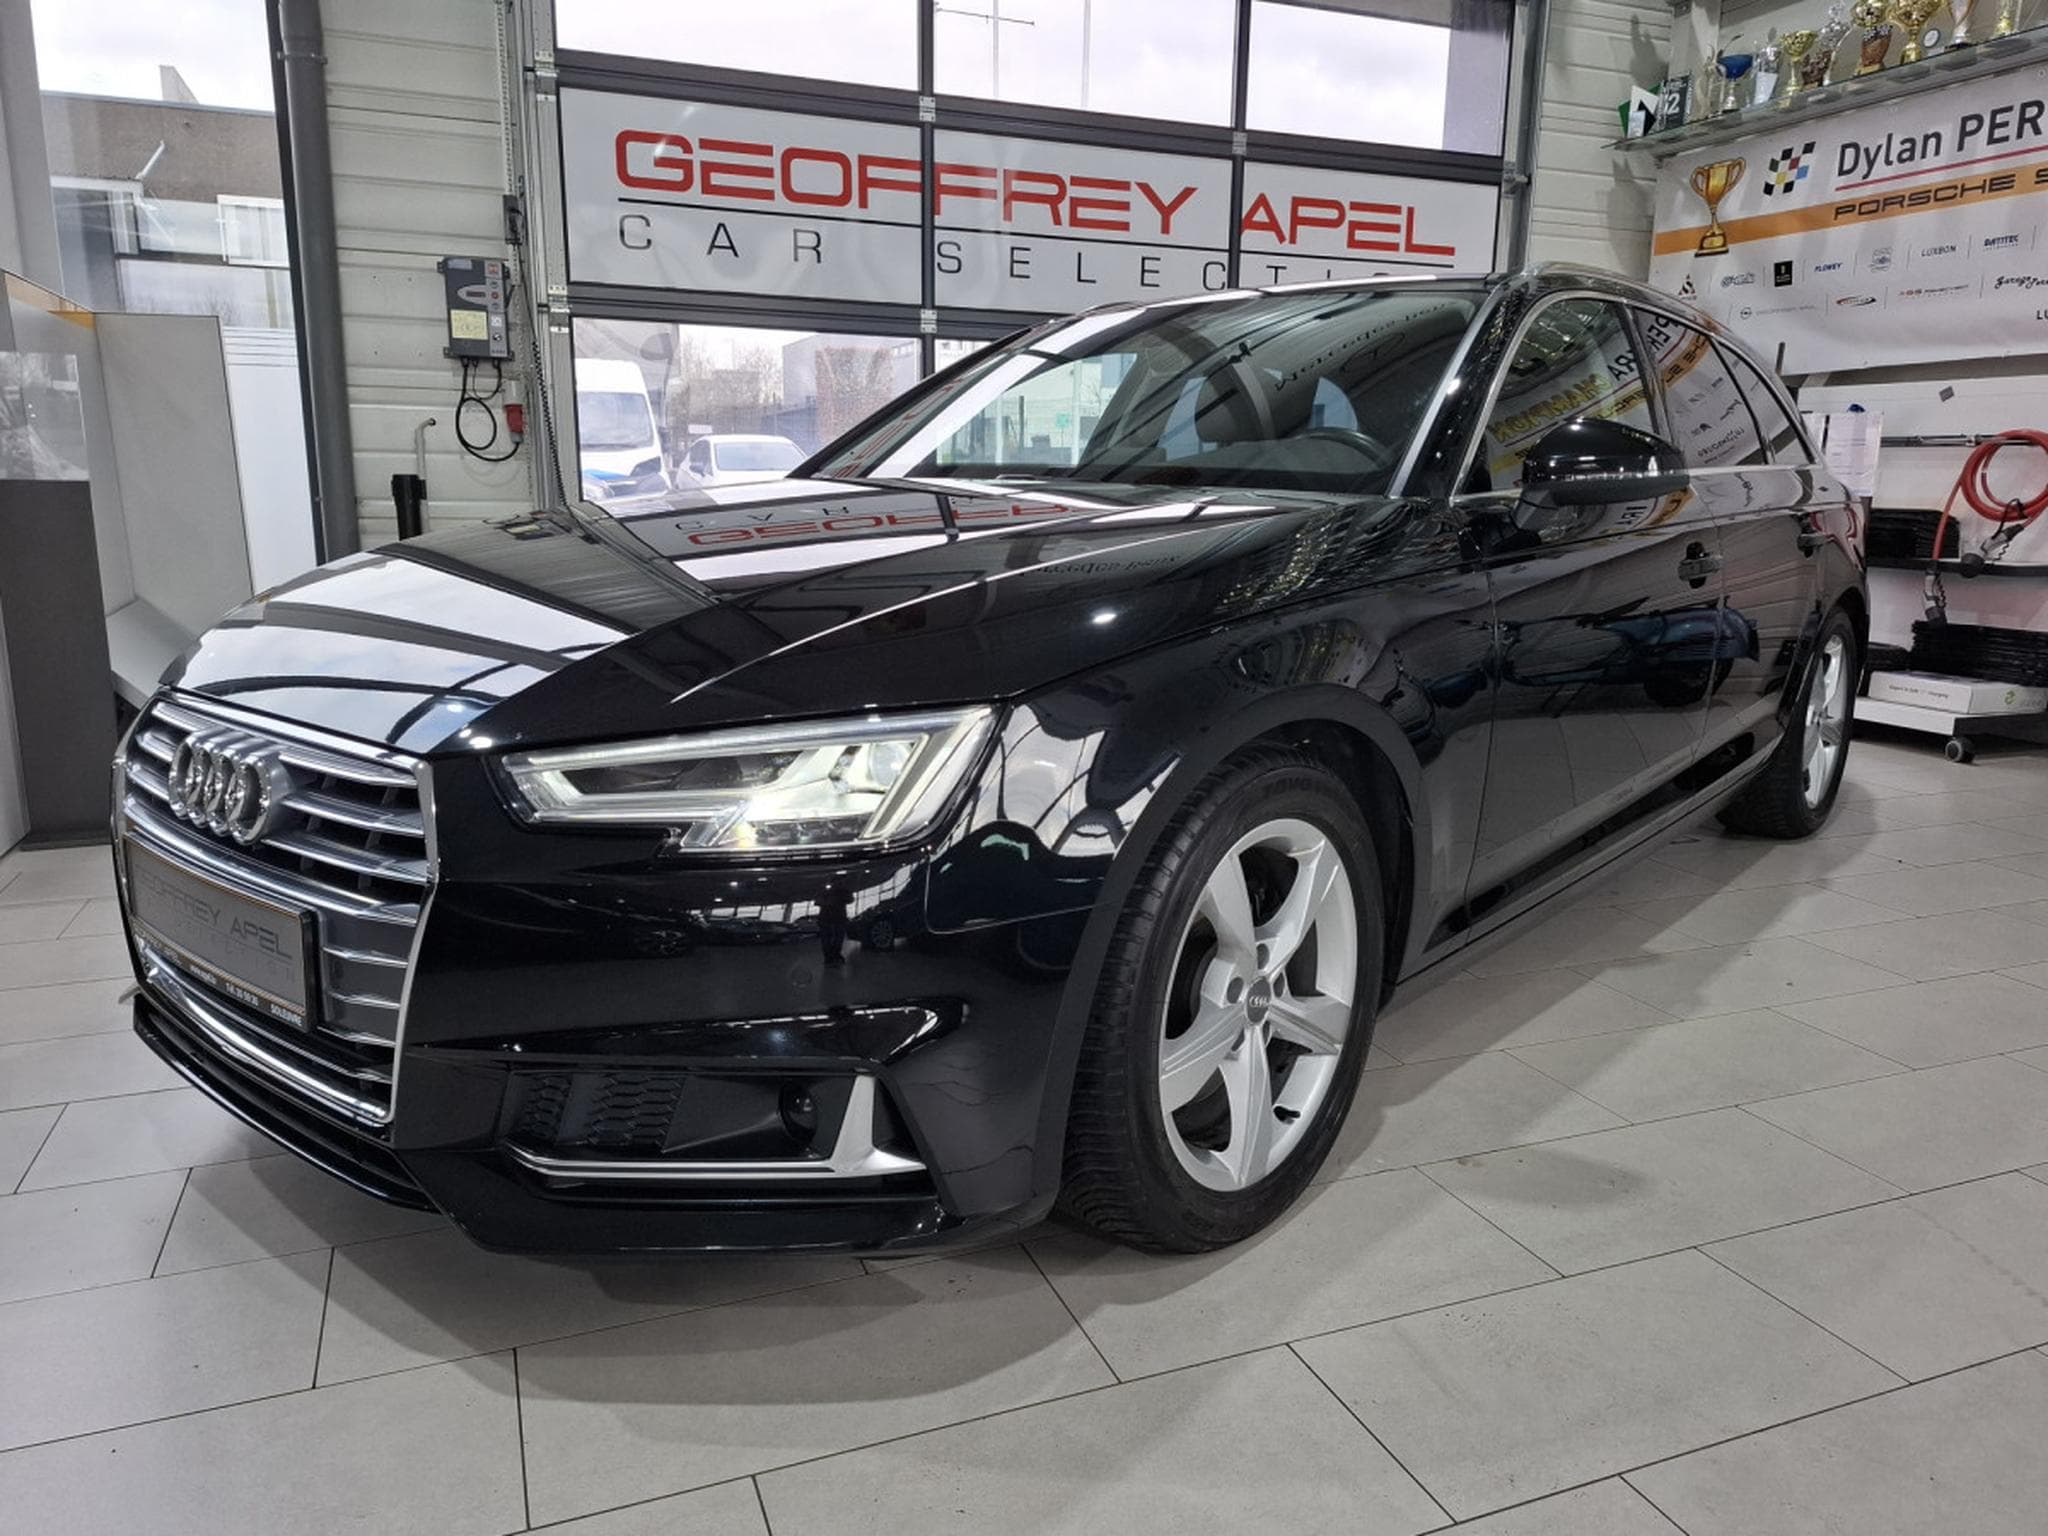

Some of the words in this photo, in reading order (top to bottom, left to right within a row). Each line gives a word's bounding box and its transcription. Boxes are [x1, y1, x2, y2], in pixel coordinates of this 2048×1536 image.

[1837, 131, 1942, 180] Dylan
[1956, 99, 2046, 152] PER
[614, 129, 1198, 235] GEOFFREY
[1240, 192, 1456, 257] APEL
[1833, 173, 2016, 221] PORSCHE
[618, 214, 823, 264] CAR
[936, 240, 1392, 293] SELECT
[229, 915, 293, 961] APEL
